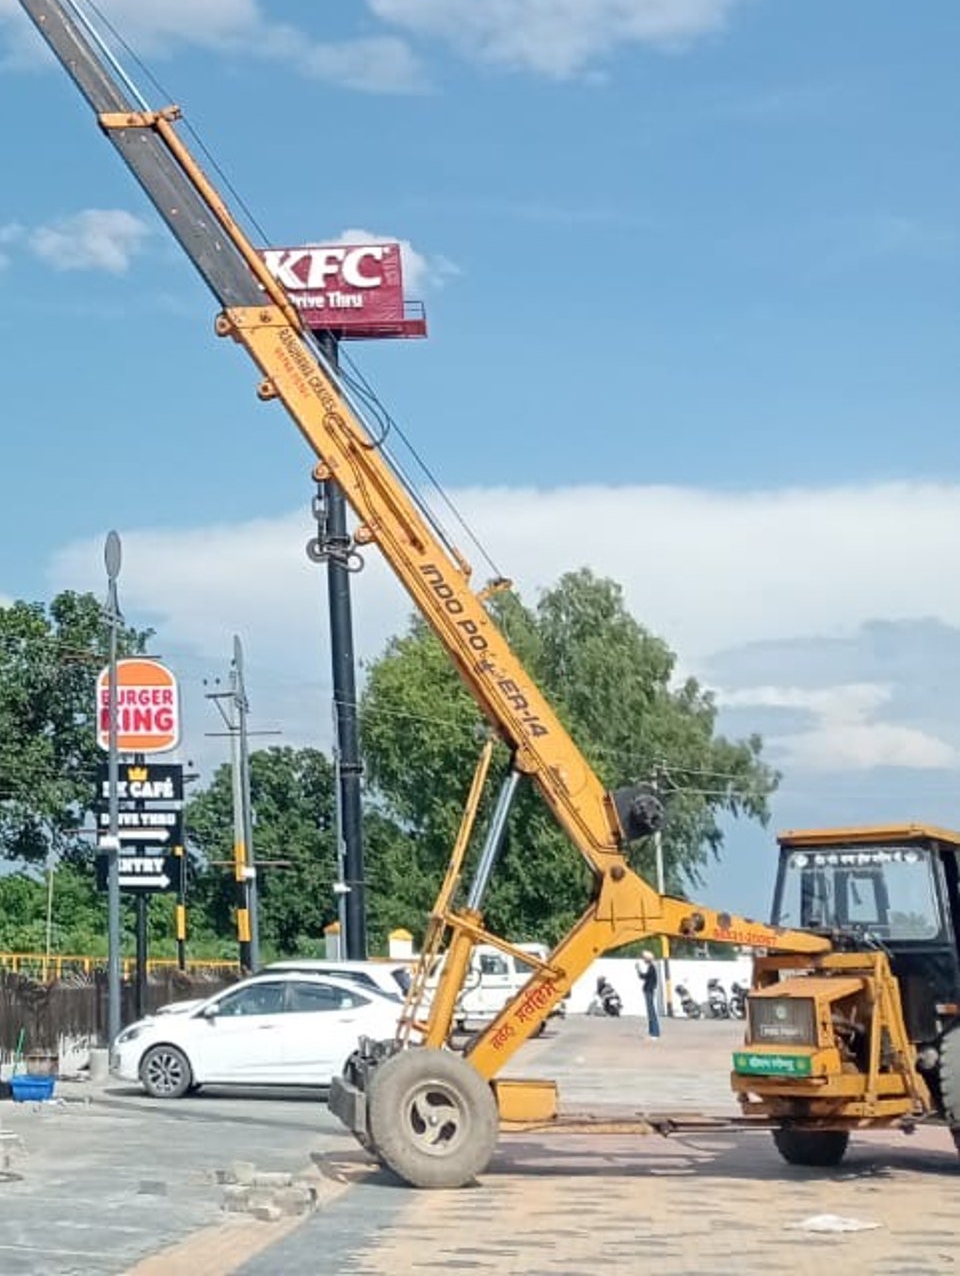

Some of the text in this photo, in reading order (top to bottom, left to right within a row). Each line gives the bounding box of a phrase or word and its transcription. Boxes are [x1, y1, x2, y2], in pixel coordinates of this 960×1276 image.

[260, 247, 383, 289] KFC
[288, 291, 364, 308] rive Thru
[420, 563, 465, 614] INDO
[129, 777, 174, 798] CAFÉ
